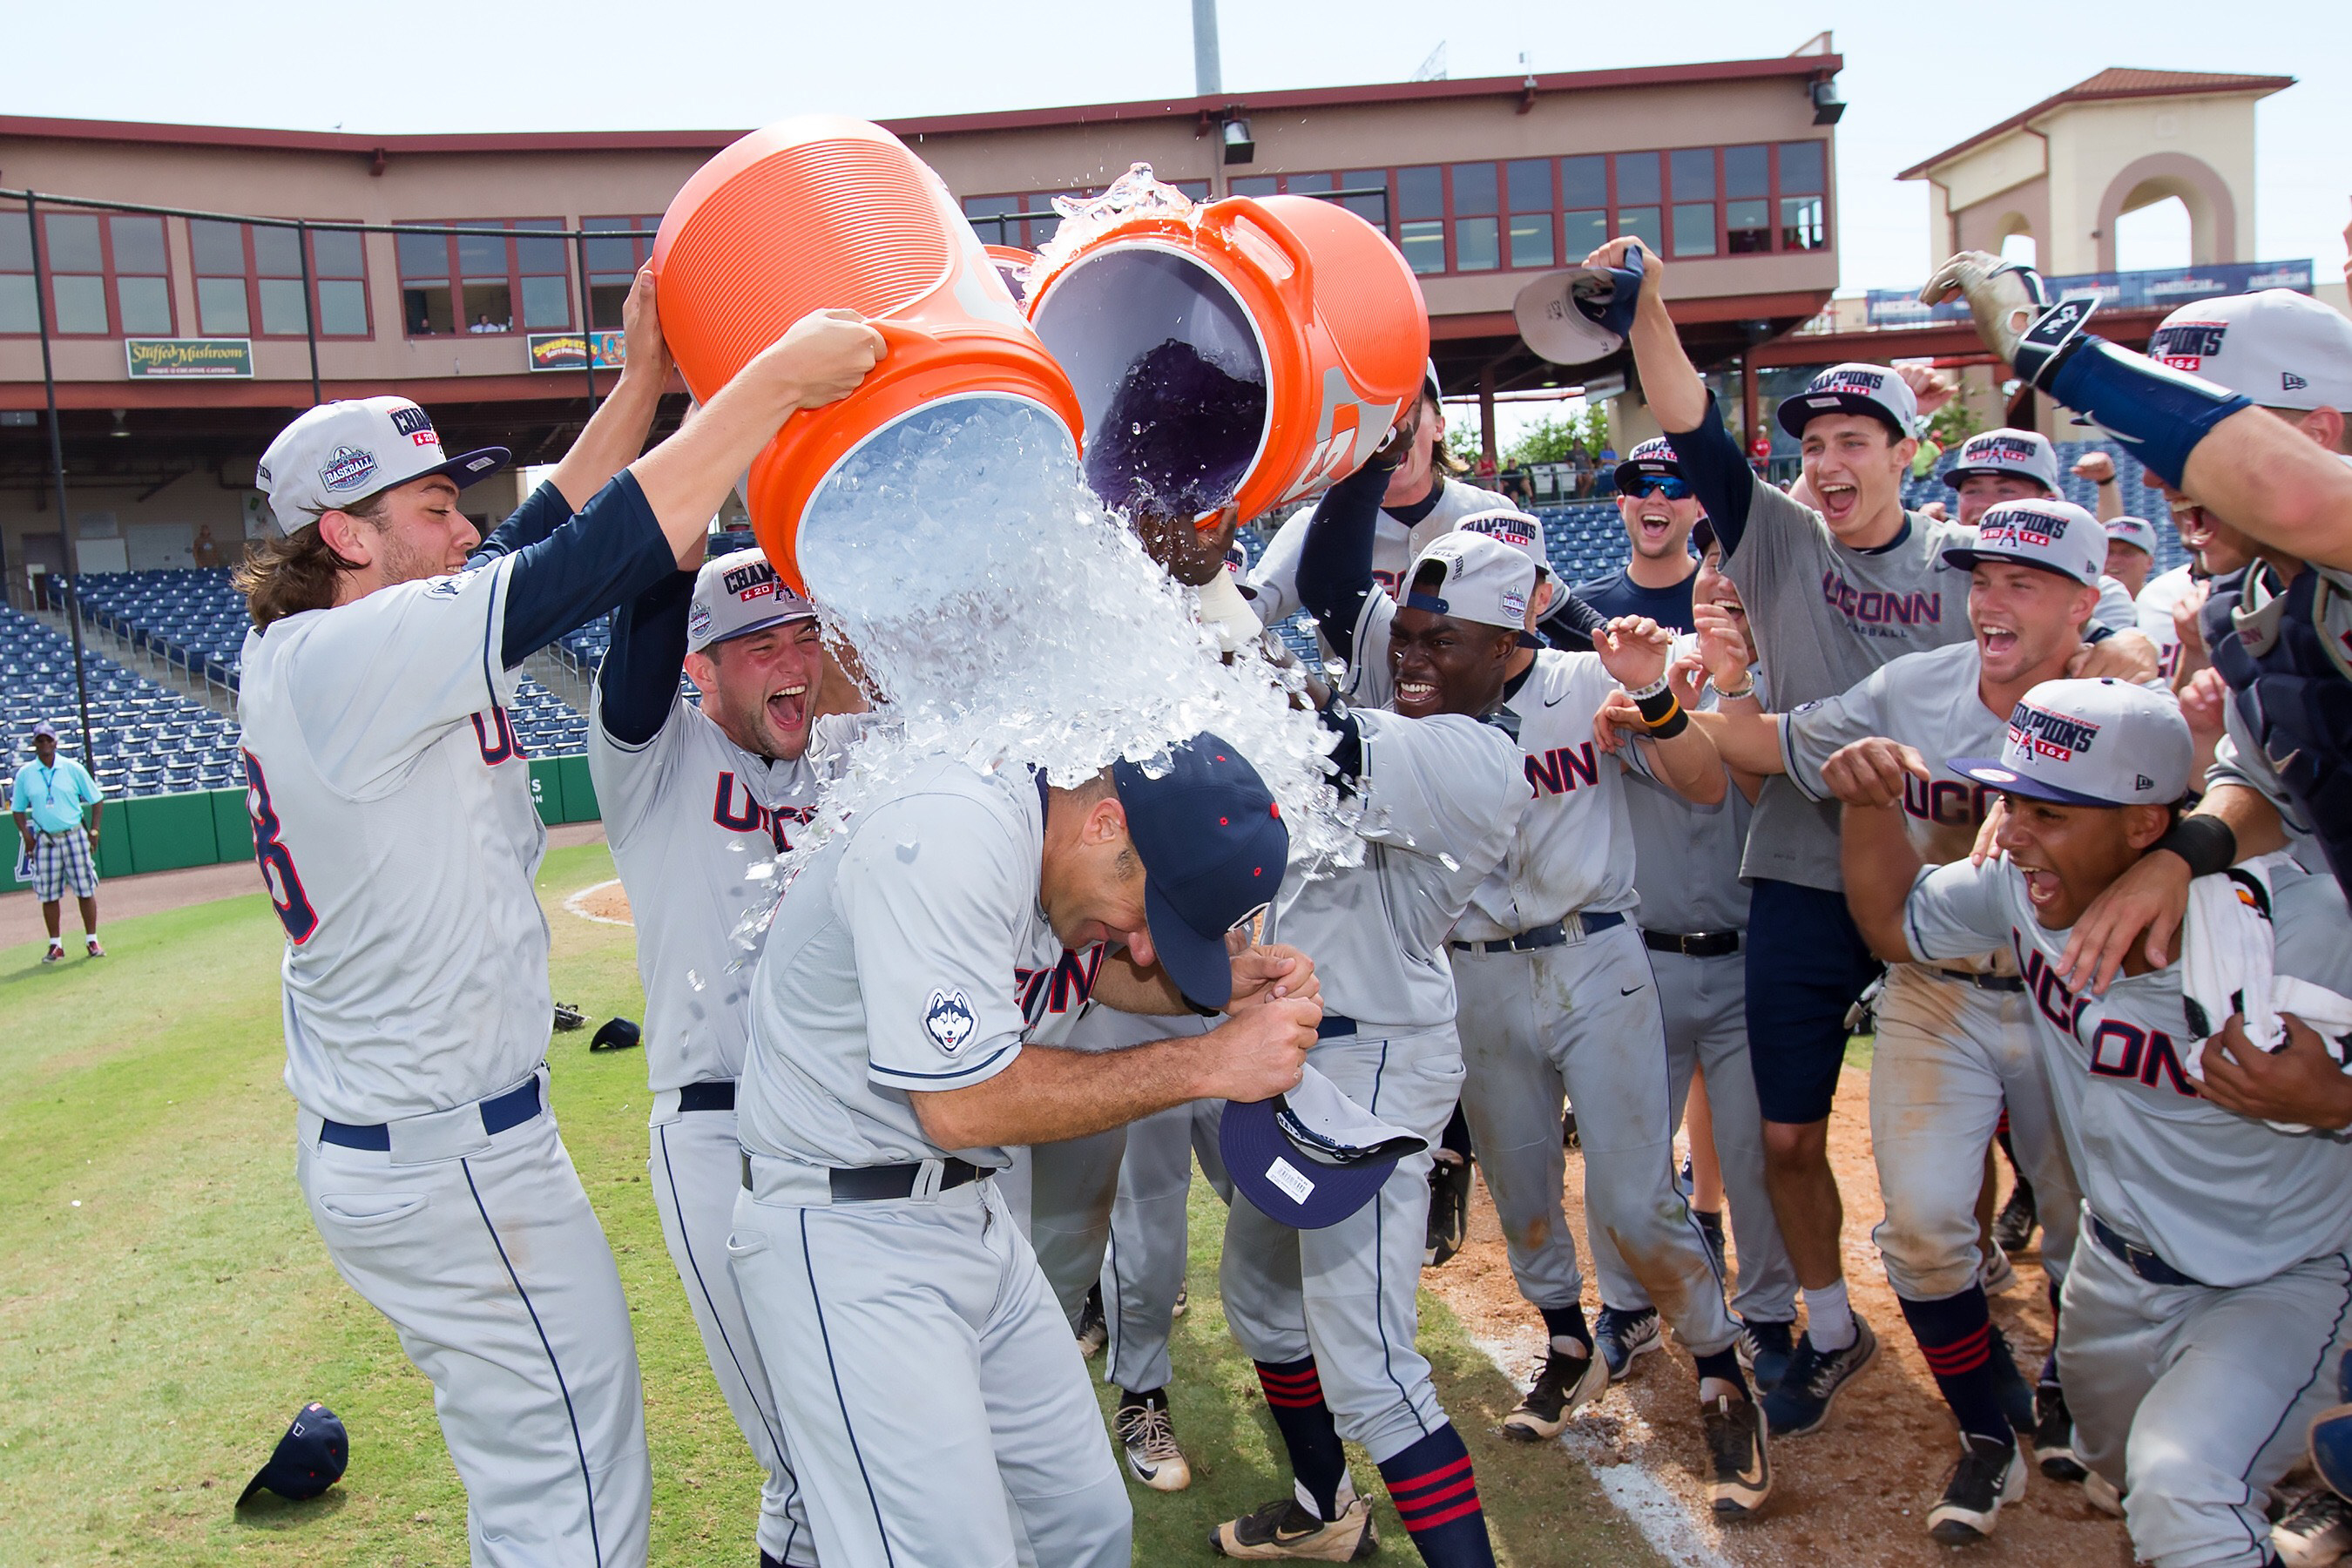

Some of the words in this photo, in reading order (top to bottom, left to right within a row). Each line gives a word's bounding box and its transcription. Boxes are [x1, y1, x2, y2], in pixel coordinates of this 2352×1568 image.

[172, 343, 247, 367] Mushroom
[326, 456, 373, 483] BASEBALL
[1460, 517, 1537, 540] CHAMPIONS
[1979, 510, 2069, 539] CHAMPIONS
[754, 585, 769, 596] 20
[1822, 571, 1941, 625] UCONN
